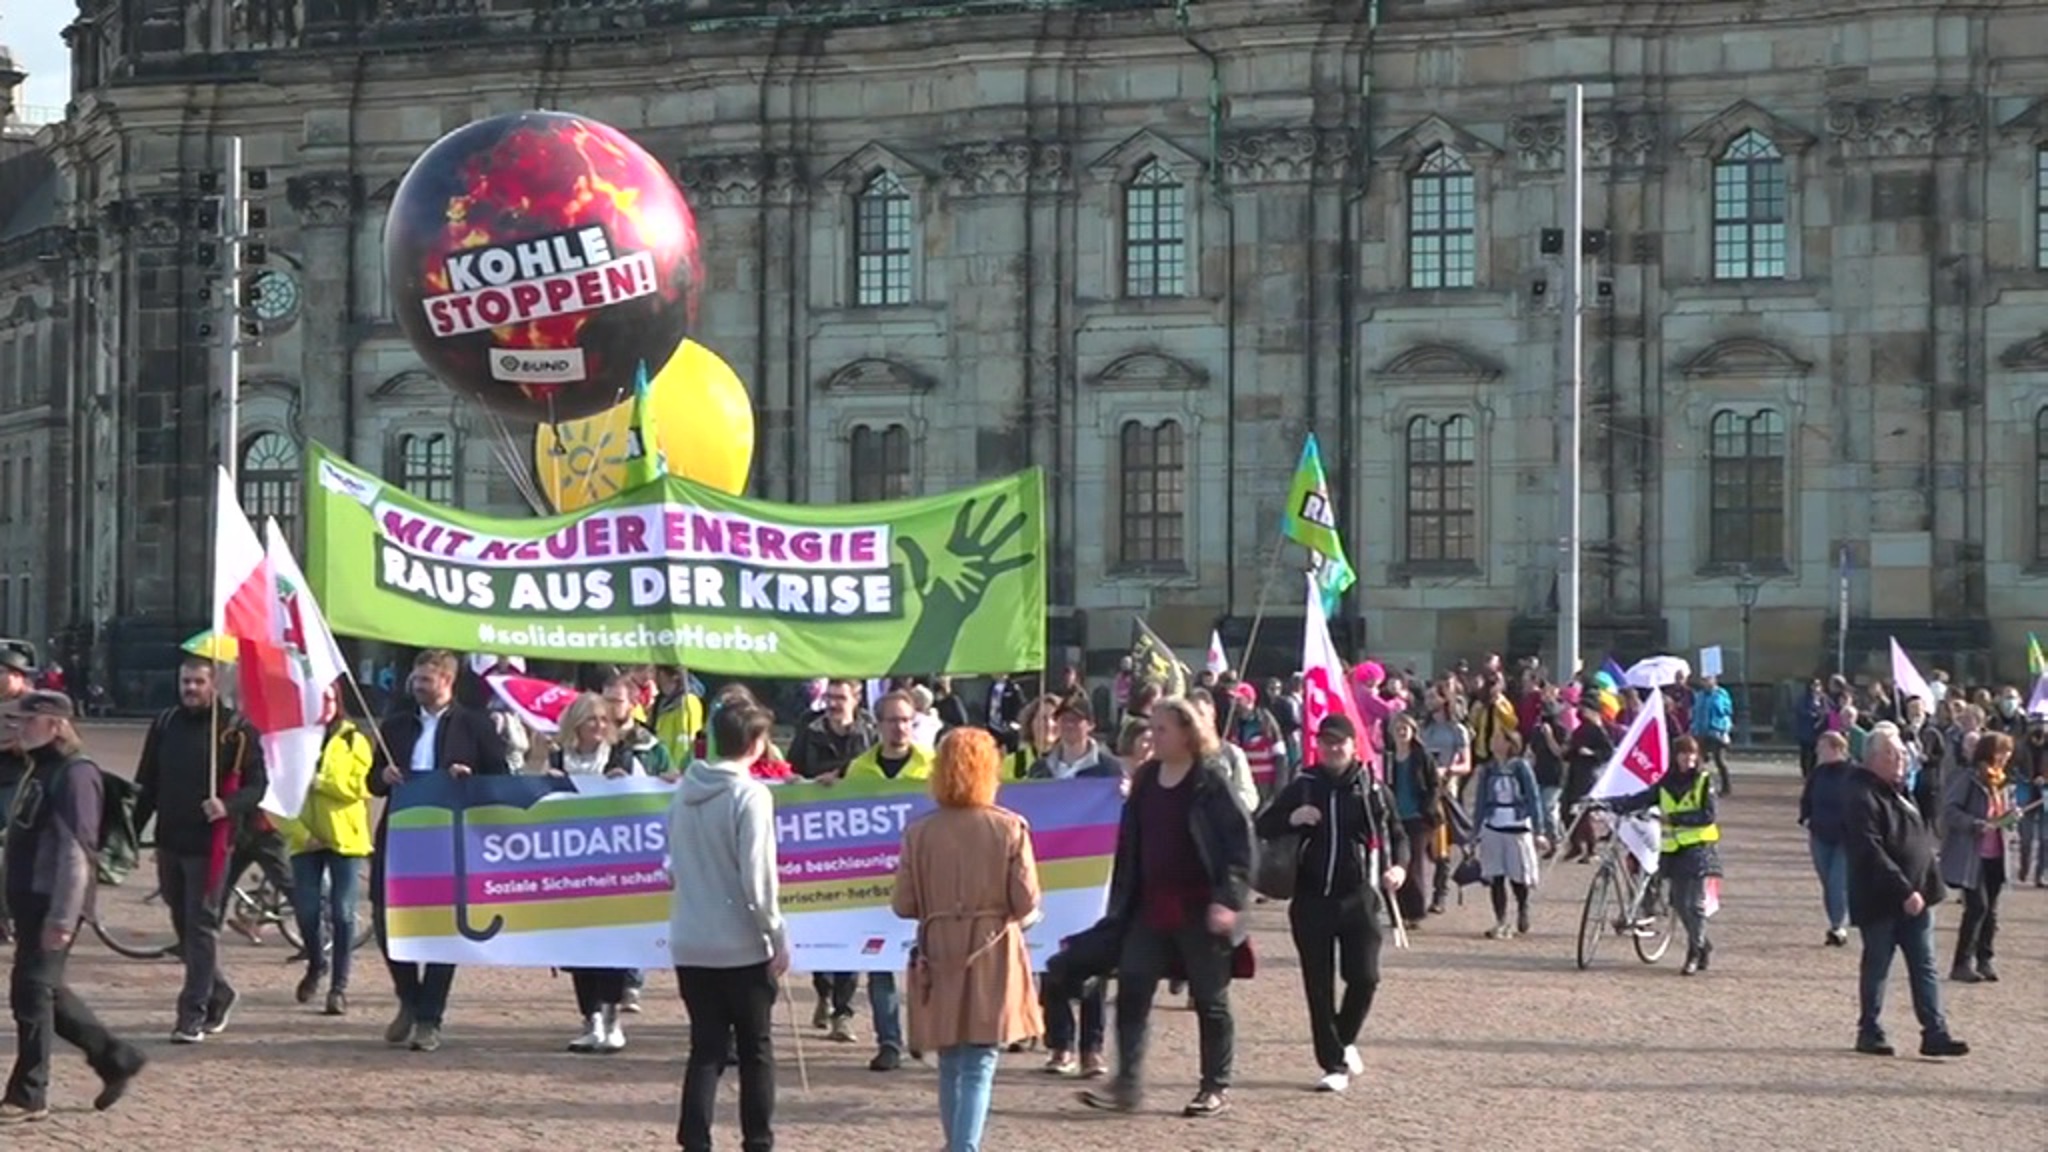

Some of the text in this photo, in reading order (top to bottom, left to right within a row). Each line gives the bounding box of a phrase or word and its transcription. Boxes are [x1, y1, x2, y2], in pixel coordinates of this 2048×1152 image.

[447, 225, 613, 292] KOHLE
[430, 259, 649, 334] STOPPEN!
[522, 360, 570, 372] BUND
[382, 510, 473, 558] MIT
[664, 511, 877, 563] ENERGIE
[382, 546, 892, 615] RAUS AUS DER KRISE
[481, 803, 913, 863] SOLIDARIS HERBST
[483, 879, 537, 895] Soziale
[541, 869, 617, 892] Sicherheit
[777, 883, 892, 904] arischer-herbs
